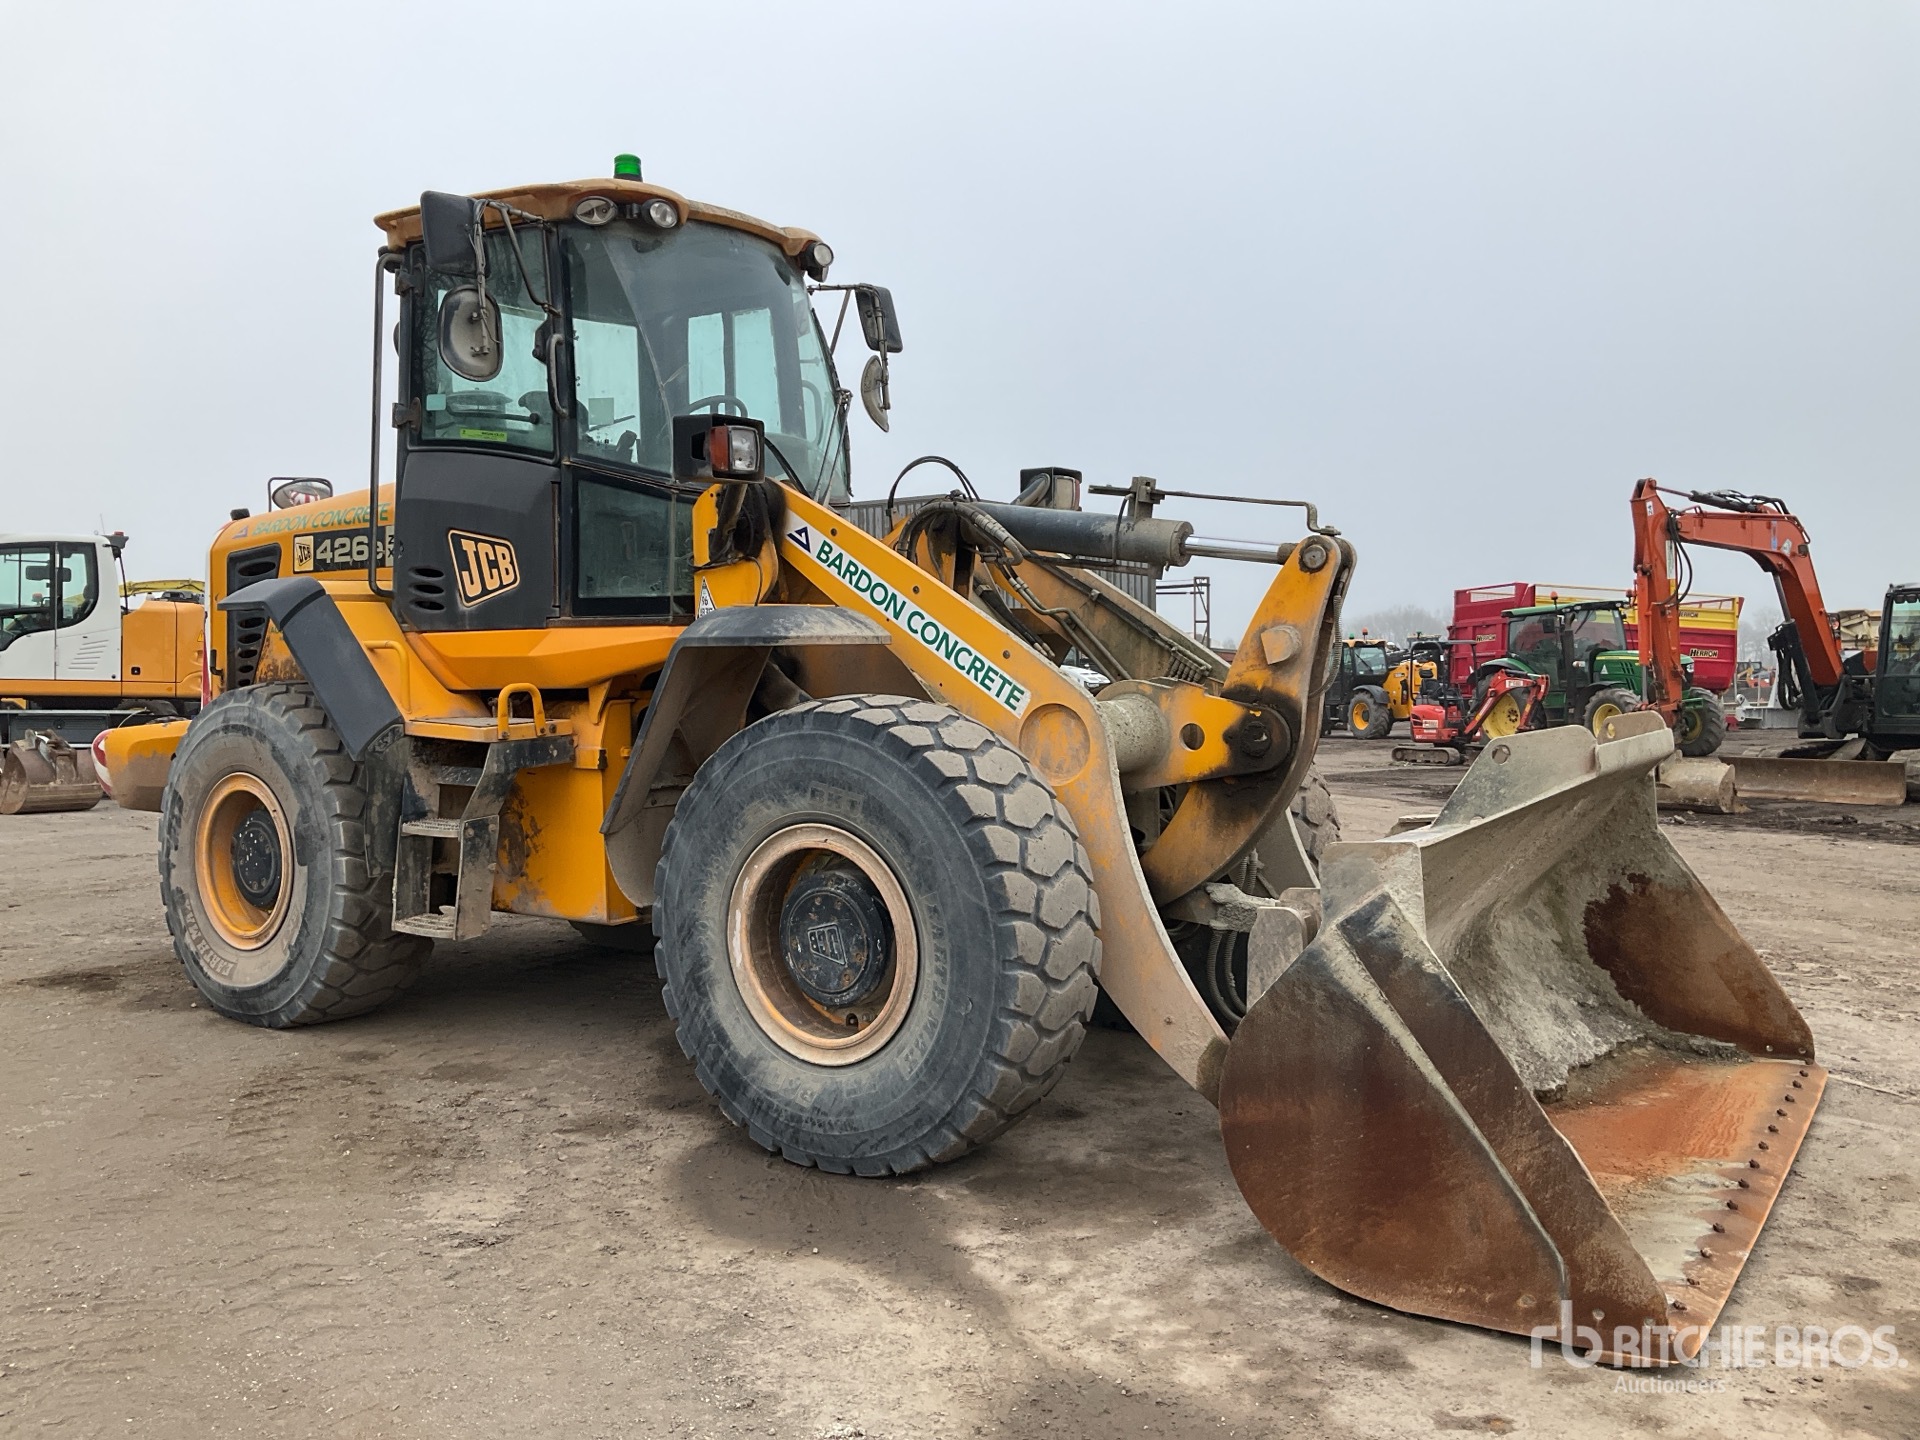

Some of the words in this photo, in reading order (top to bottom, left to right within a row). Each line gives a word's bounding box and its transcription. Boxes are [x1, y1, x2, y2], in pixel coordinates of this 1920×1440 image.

[252, 513, 312, 536] BARDON
[312, 503, 392, 528] CONCREE
[461, 538, 515, 598] JCB
[815, 540, 907, 621] BARDON
[906, 610, 1026, 711] CONCRETE
[1690, 649, 1718, 658] HERRON
